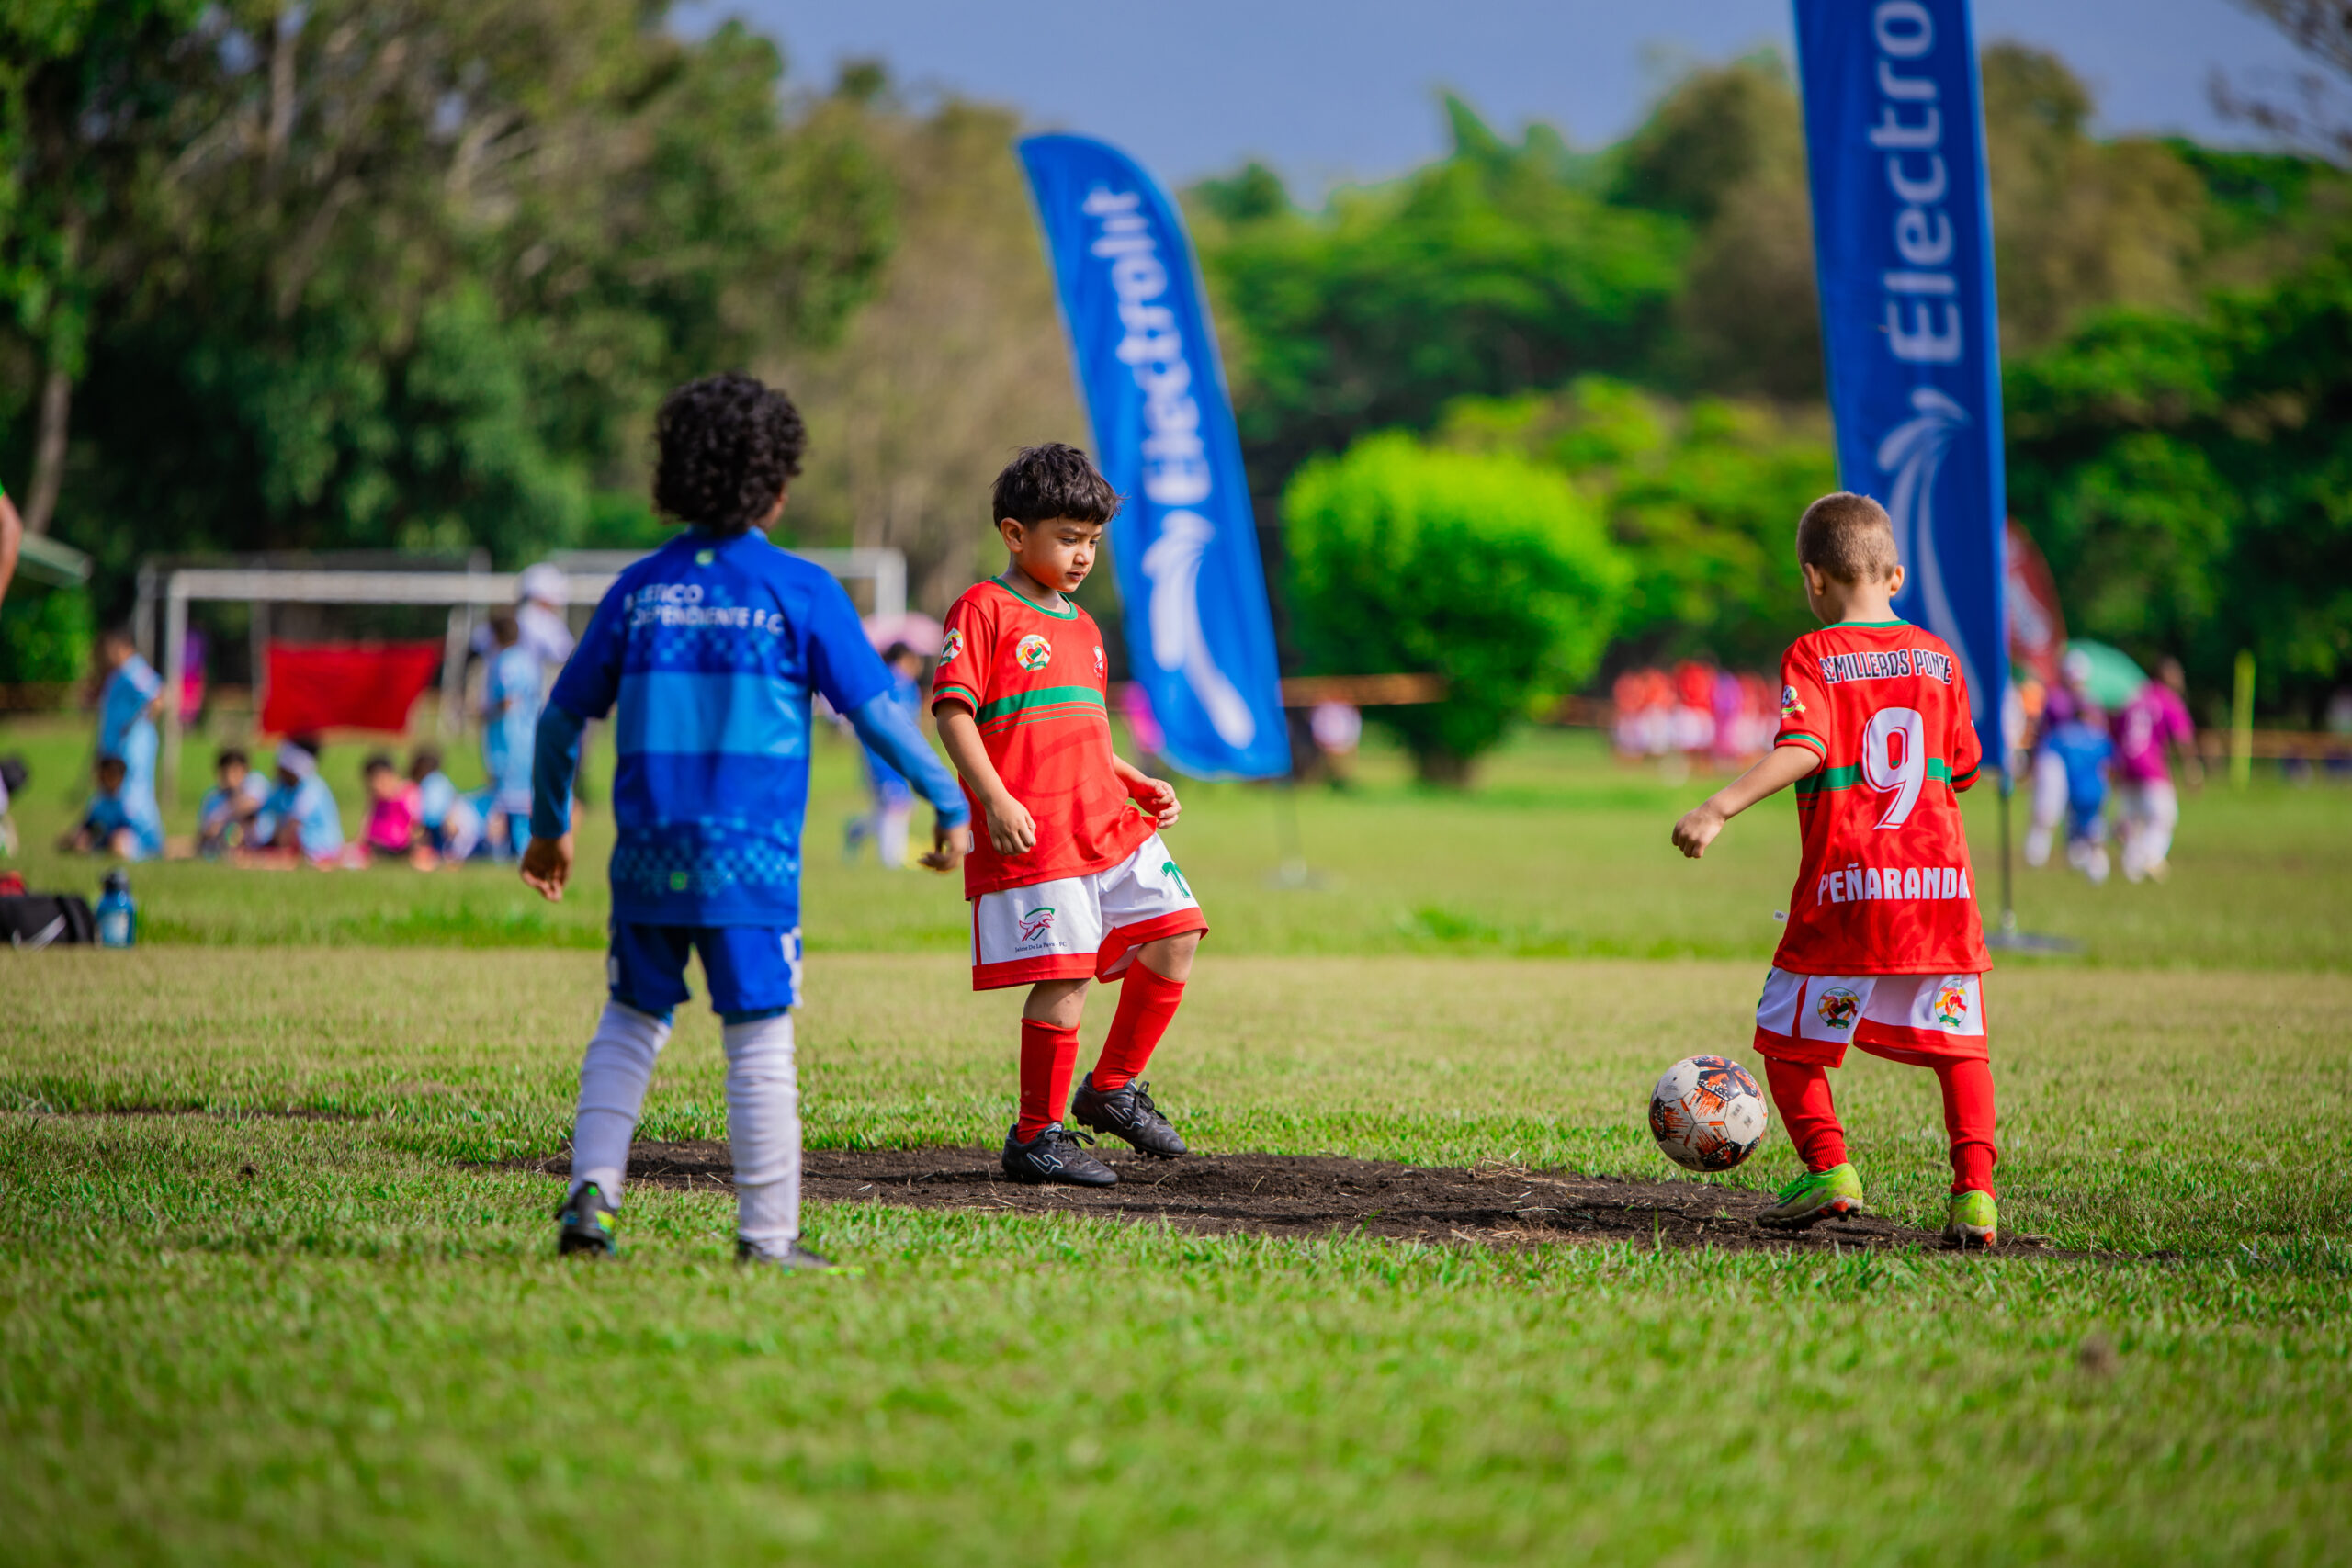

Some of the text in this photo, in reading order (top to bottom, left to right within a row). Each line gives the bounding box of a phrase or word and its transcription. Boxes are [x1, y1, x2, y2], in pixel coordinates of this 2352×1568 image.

[1867, 0, 1963, 362] Electro
[1081, 182, 1213, 504] Electrolit
[1862, 706, 1925, 829] 9
[1817, 863, 1971, 906] PEÑARANDA
